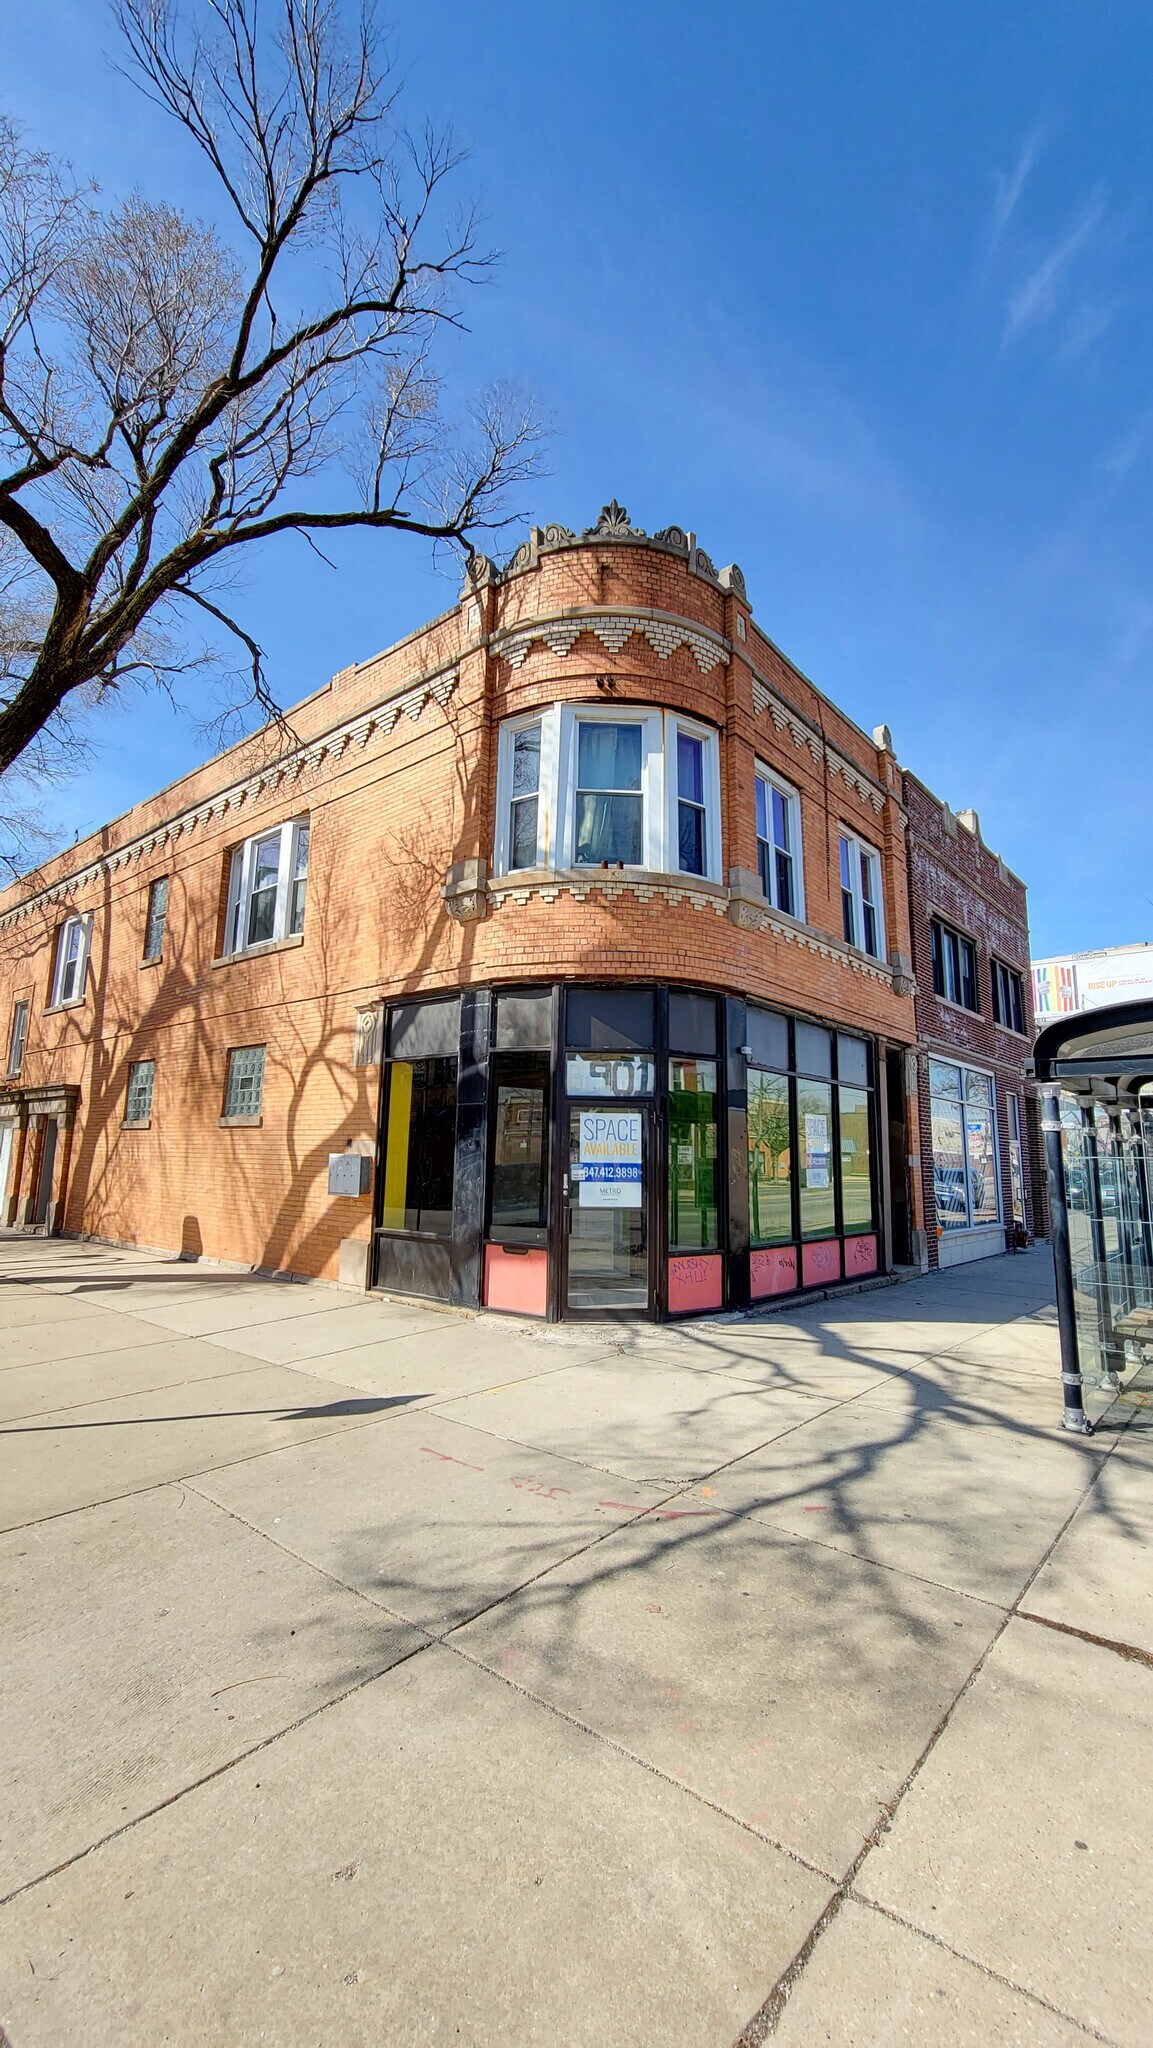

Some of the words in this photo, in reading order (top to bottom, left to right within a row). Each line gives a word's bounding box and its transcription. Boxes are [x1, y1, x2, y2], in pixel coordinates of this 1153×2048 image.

[1088, 981, 1106, 990] RISE
[1106, 980, 1117, 988] UP
[583, 1118, 638, 1141] SPACE
[583, 1142, 638, 1156] AVAILABLE
